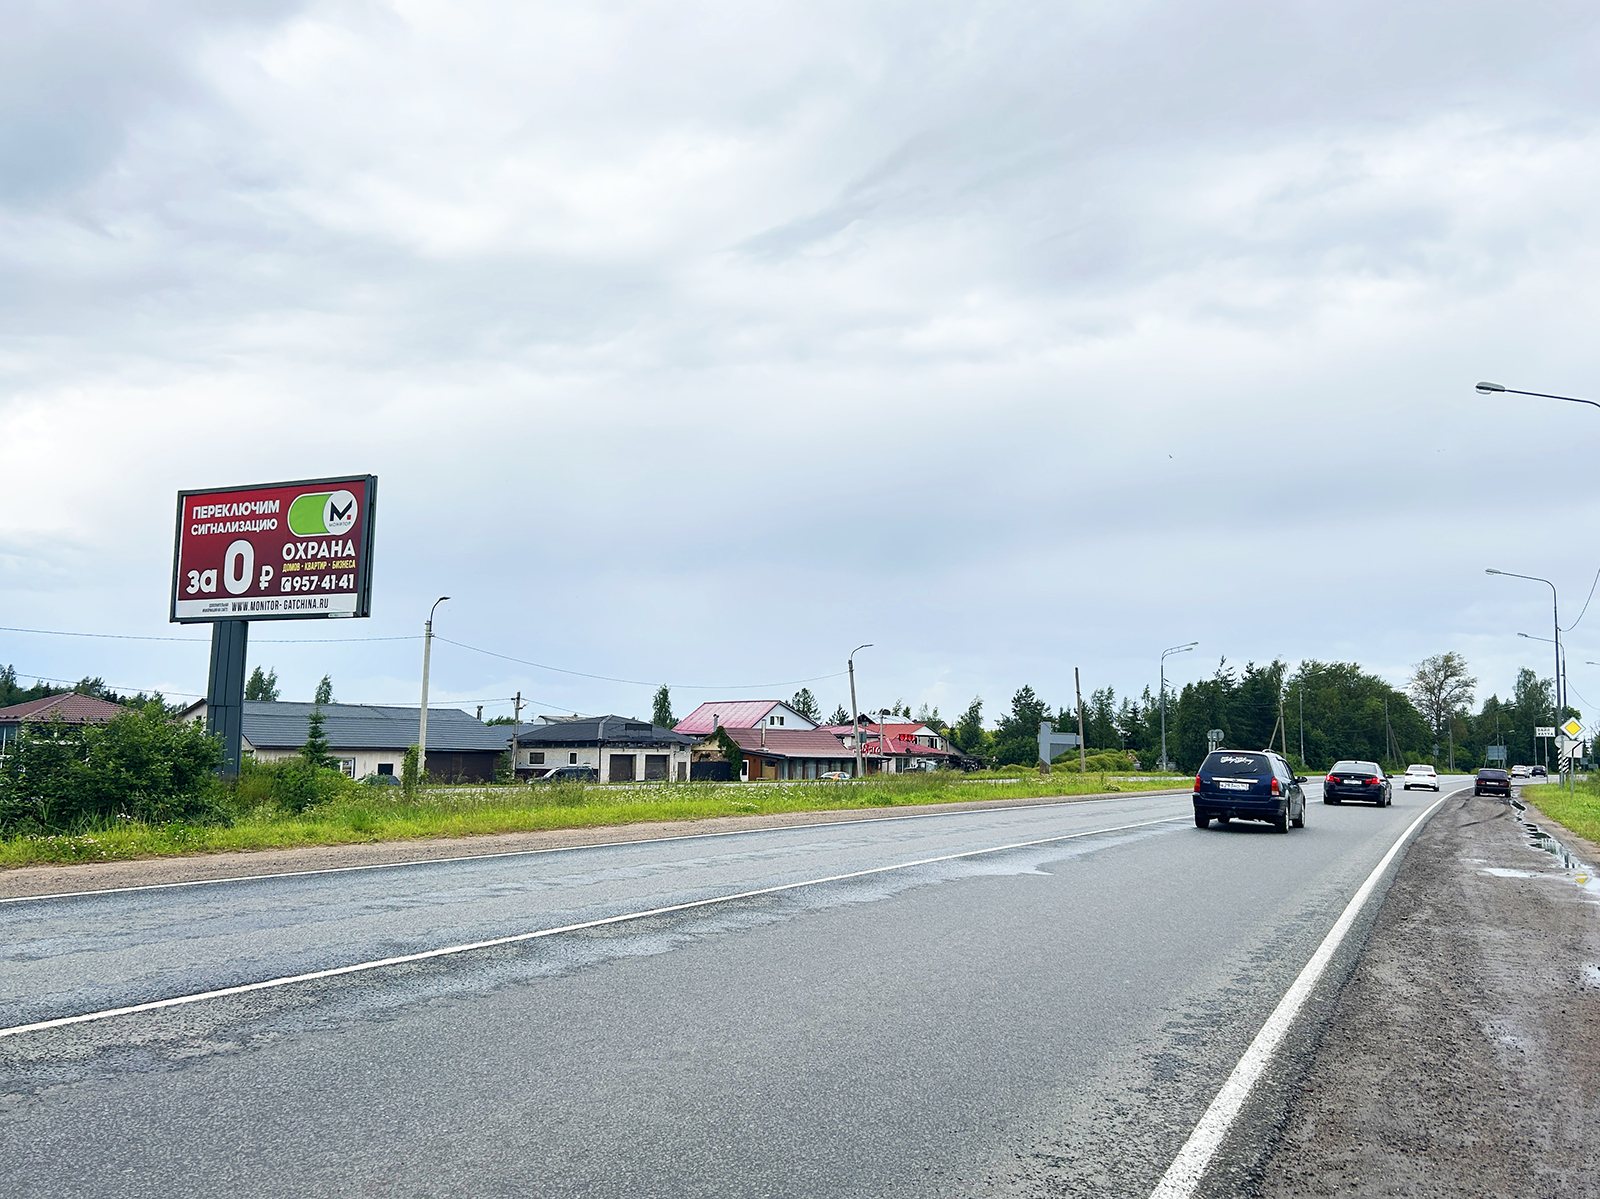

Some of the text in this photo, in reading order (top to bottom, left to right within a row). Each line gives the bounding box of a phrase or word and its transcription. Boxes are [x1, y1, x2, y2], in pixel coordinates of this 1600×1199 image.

[192, 500, 280, 519] ПЕРЕКЛЮЧИМ
[191, 518, 278, 535] СИГНАЛИЗАЦИЮ
[282, 539, 356, 560] ОХРАНА
[223, 539, 255, 595] 0
[282, 560, 356, 573] ДОМОВ КВАРТИР БИЗНЕСА
